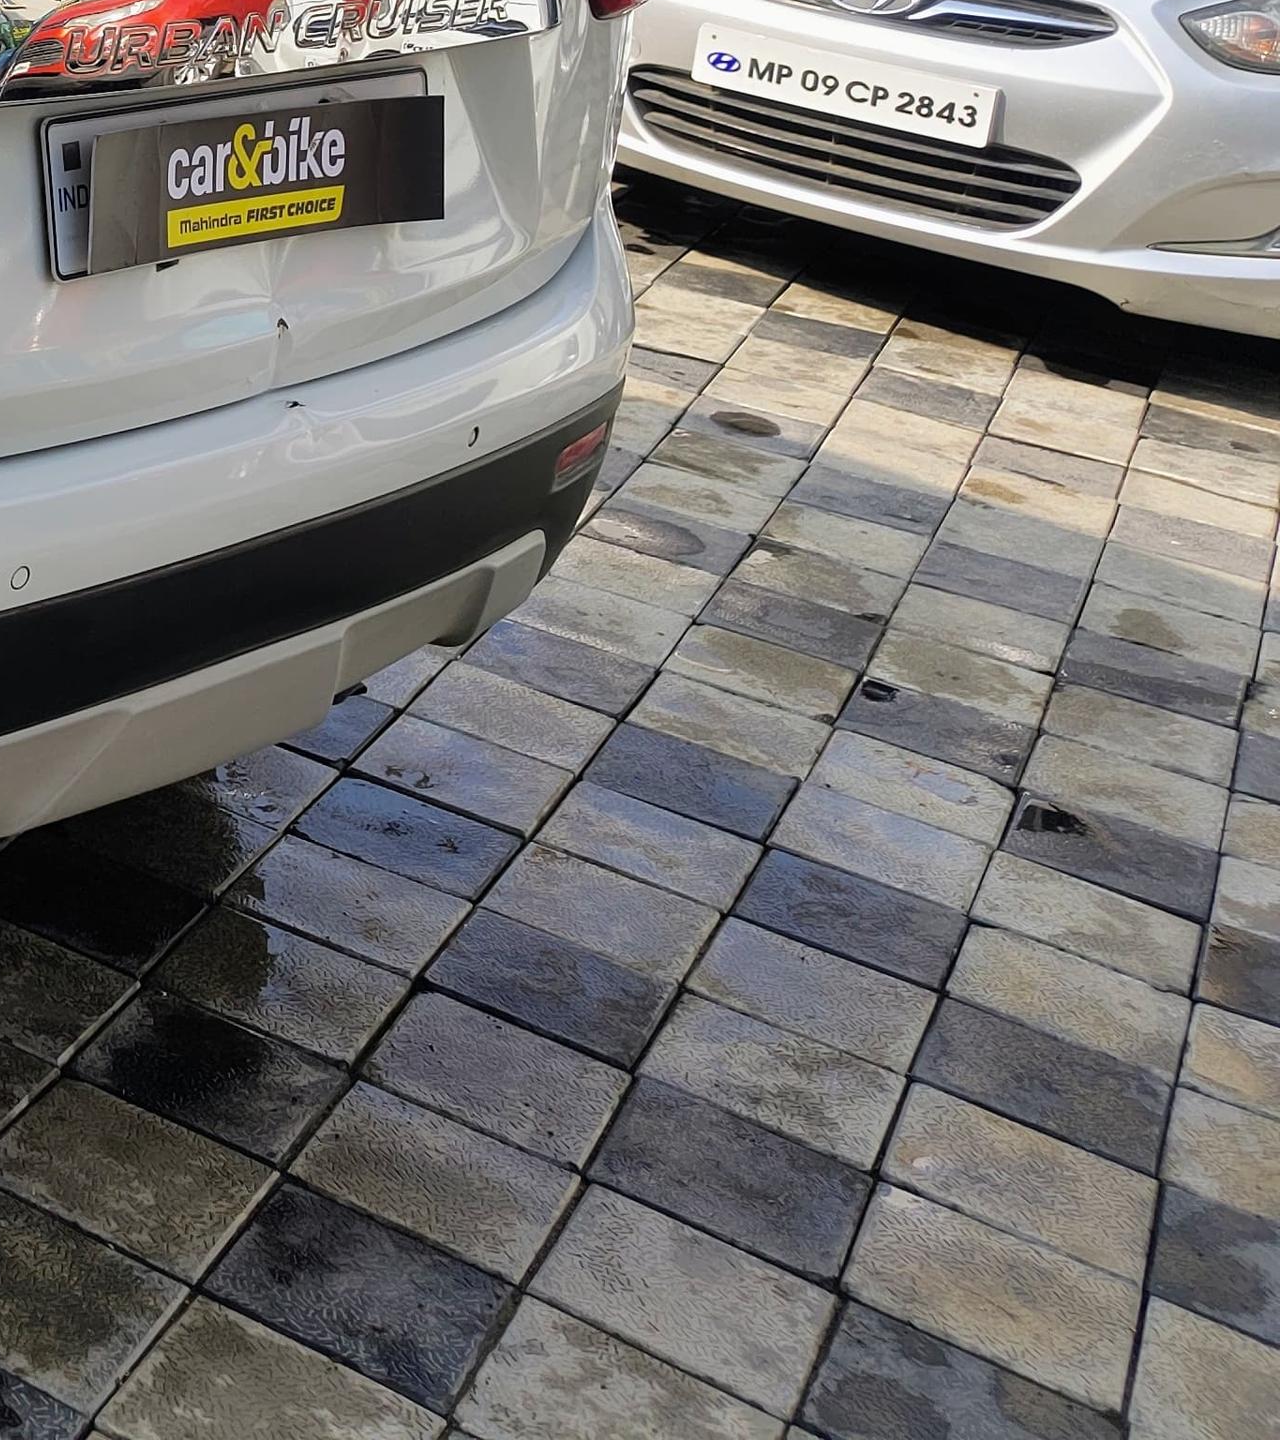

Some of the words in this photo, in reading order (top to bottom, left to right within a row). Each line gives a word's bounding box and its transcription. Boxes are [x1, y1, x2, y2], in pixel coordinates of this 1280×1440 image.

[63, 9, 284, 75] URBAN
[748, 58, 793, 86] MP
[800, 69, 839, 96] 09
[845, 80, 889, 107] CP
[895, 92, 978, 128] 2843
[167, 116, 345, 200] car&bike
[58, 184, 89, 212] IND
[180, 212, 242, 234] Mahindra
[246, 205, 286, 223] FIRST
[287, 197, 336, 216] CHOICE
